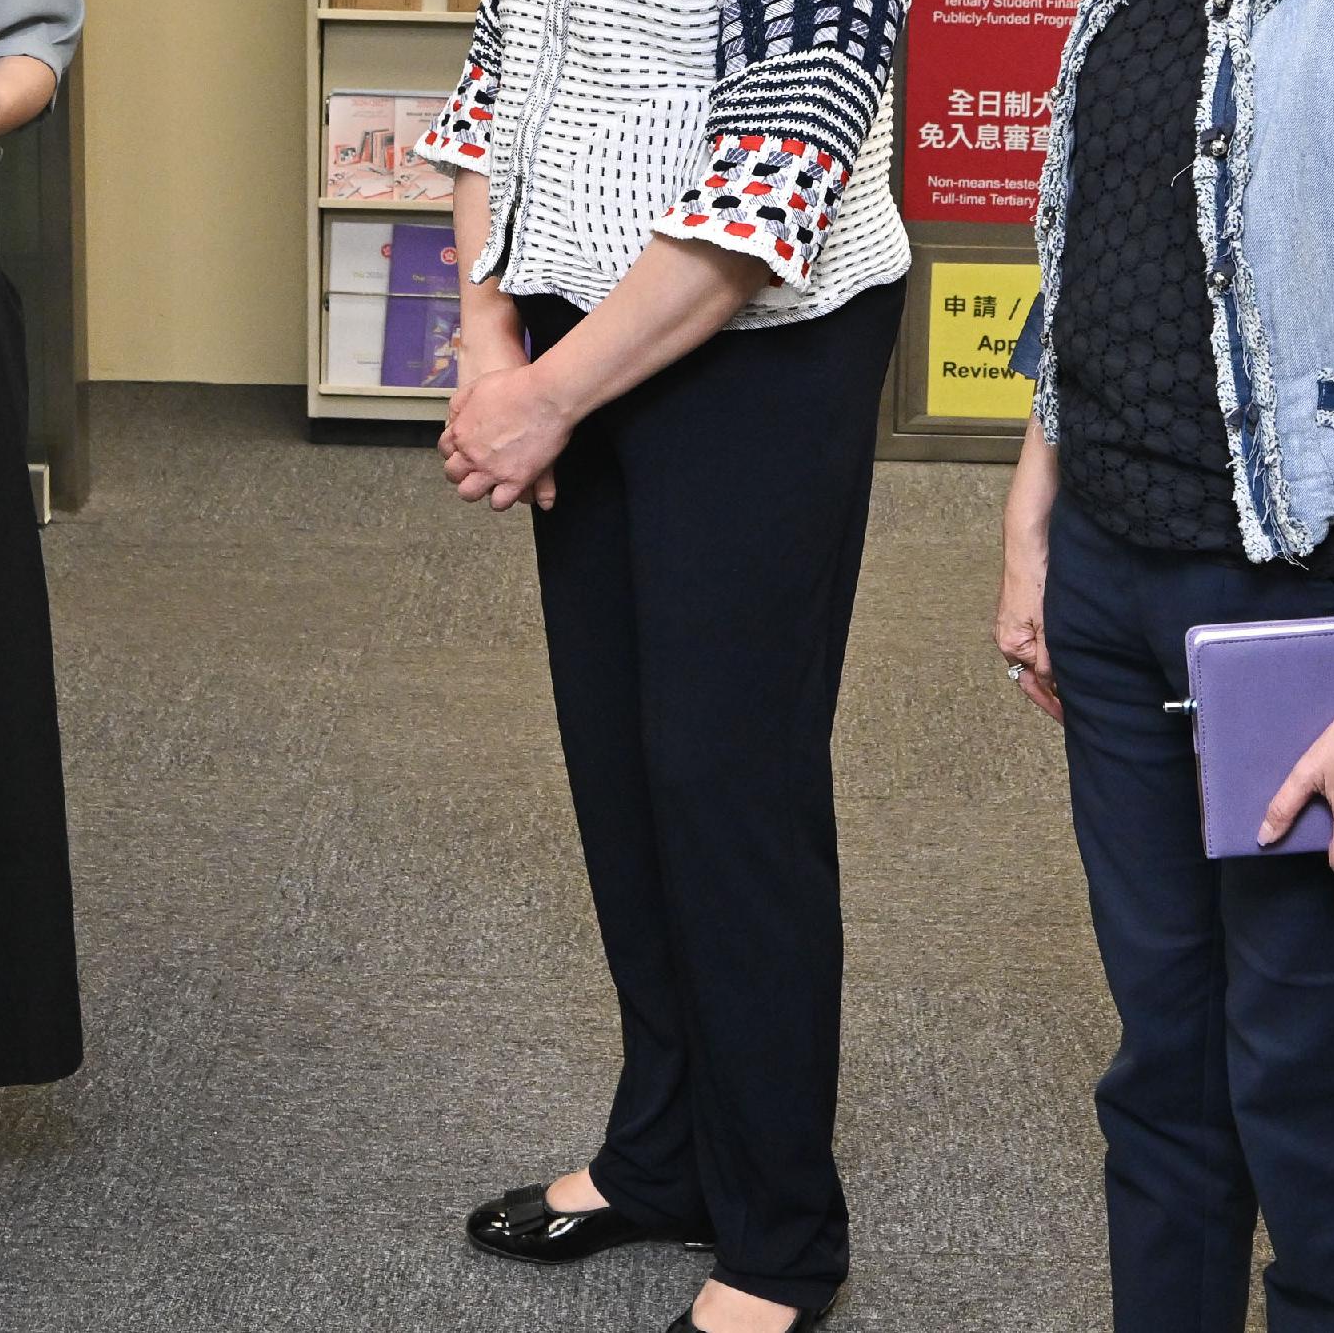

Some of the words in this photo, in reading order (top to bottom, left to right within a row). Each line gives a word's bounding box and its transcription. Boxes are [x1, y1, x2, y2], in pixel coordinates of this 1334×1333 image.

[932, 11, 1030, 27] Publicly-funded
[947, 89, 1054, 118] 全日制大
[918, 122, 1051, 151] 免入息審查
[932, 192, 986, 205] Full-time
[990, 194, 1036, 209] Tertiary
[943, 362, 1016, 379] Review
